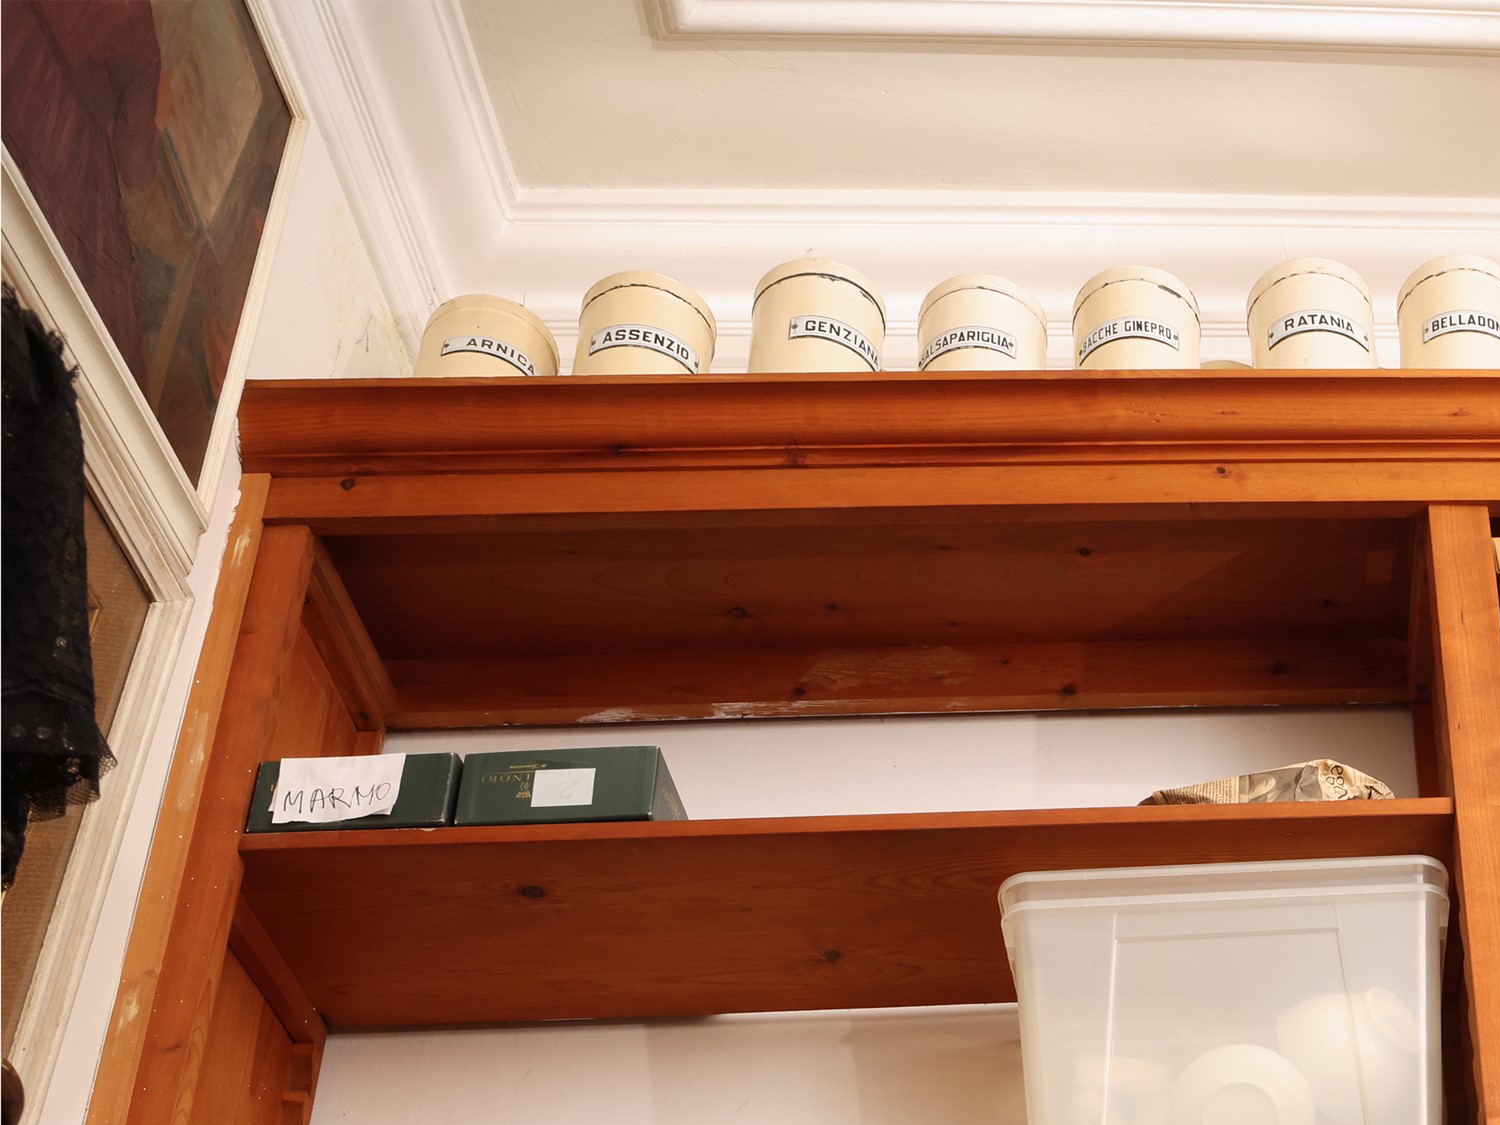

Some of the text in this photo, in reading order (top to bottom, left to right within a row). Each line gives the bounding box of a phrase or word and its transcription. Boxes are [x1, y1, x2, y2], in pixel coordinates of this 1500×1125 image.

[1082, 320, 1172, 354] BACCHE GINEPRO
[1284, 314, 1355, 334] RATANIA
[466, 336, 535, 375] ARNICA
[602, 328, 690, 361] ASSENZIO
[805, 319, 880, 370] GENZIANA
[480, 773, 531, 784] INORI
[283, 782, 391, 815] MARMO
